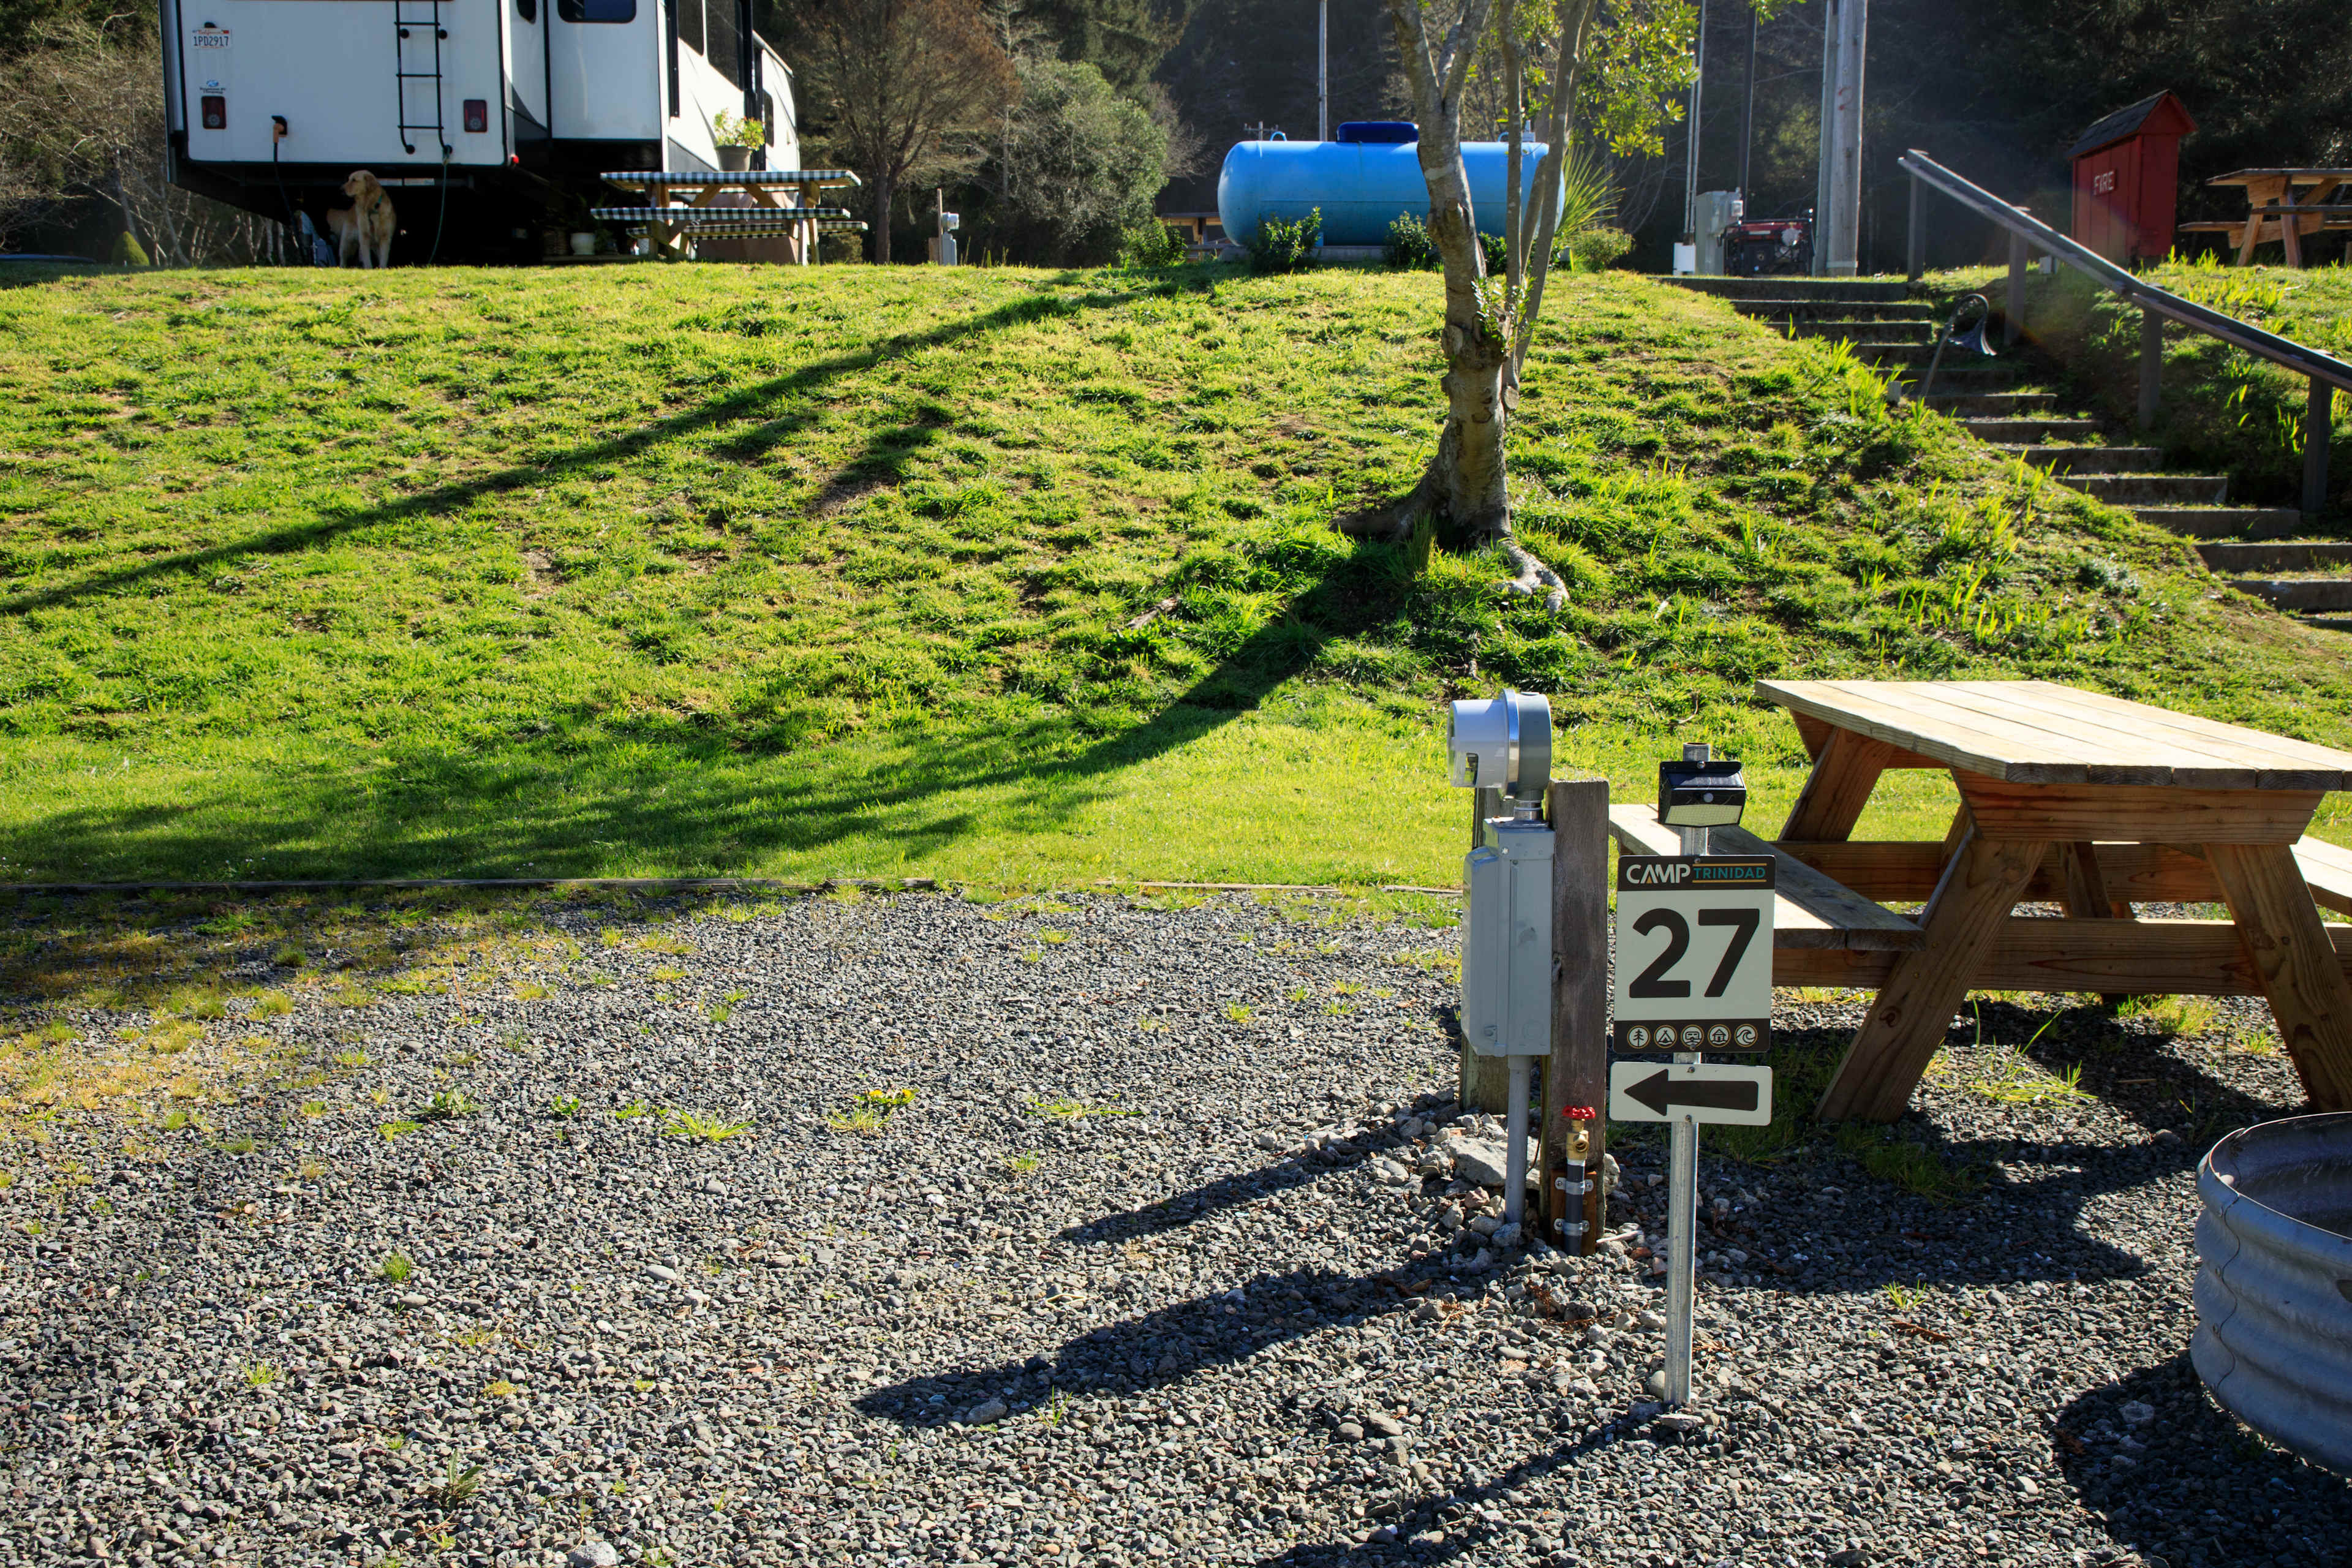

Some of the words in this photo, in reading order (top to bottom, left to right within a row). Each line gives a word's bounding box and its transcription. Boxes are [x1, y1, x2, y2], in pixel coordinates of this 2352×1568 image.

[194, 36, 229, 46] 1PD2917
[2094, 171, 2114, 195] FIRE
[1626, 864, 1691, 884] CAMP
[1694, 867, 1766, 879] TRINIDAD
[1629, 908, 1760, 998] 27
